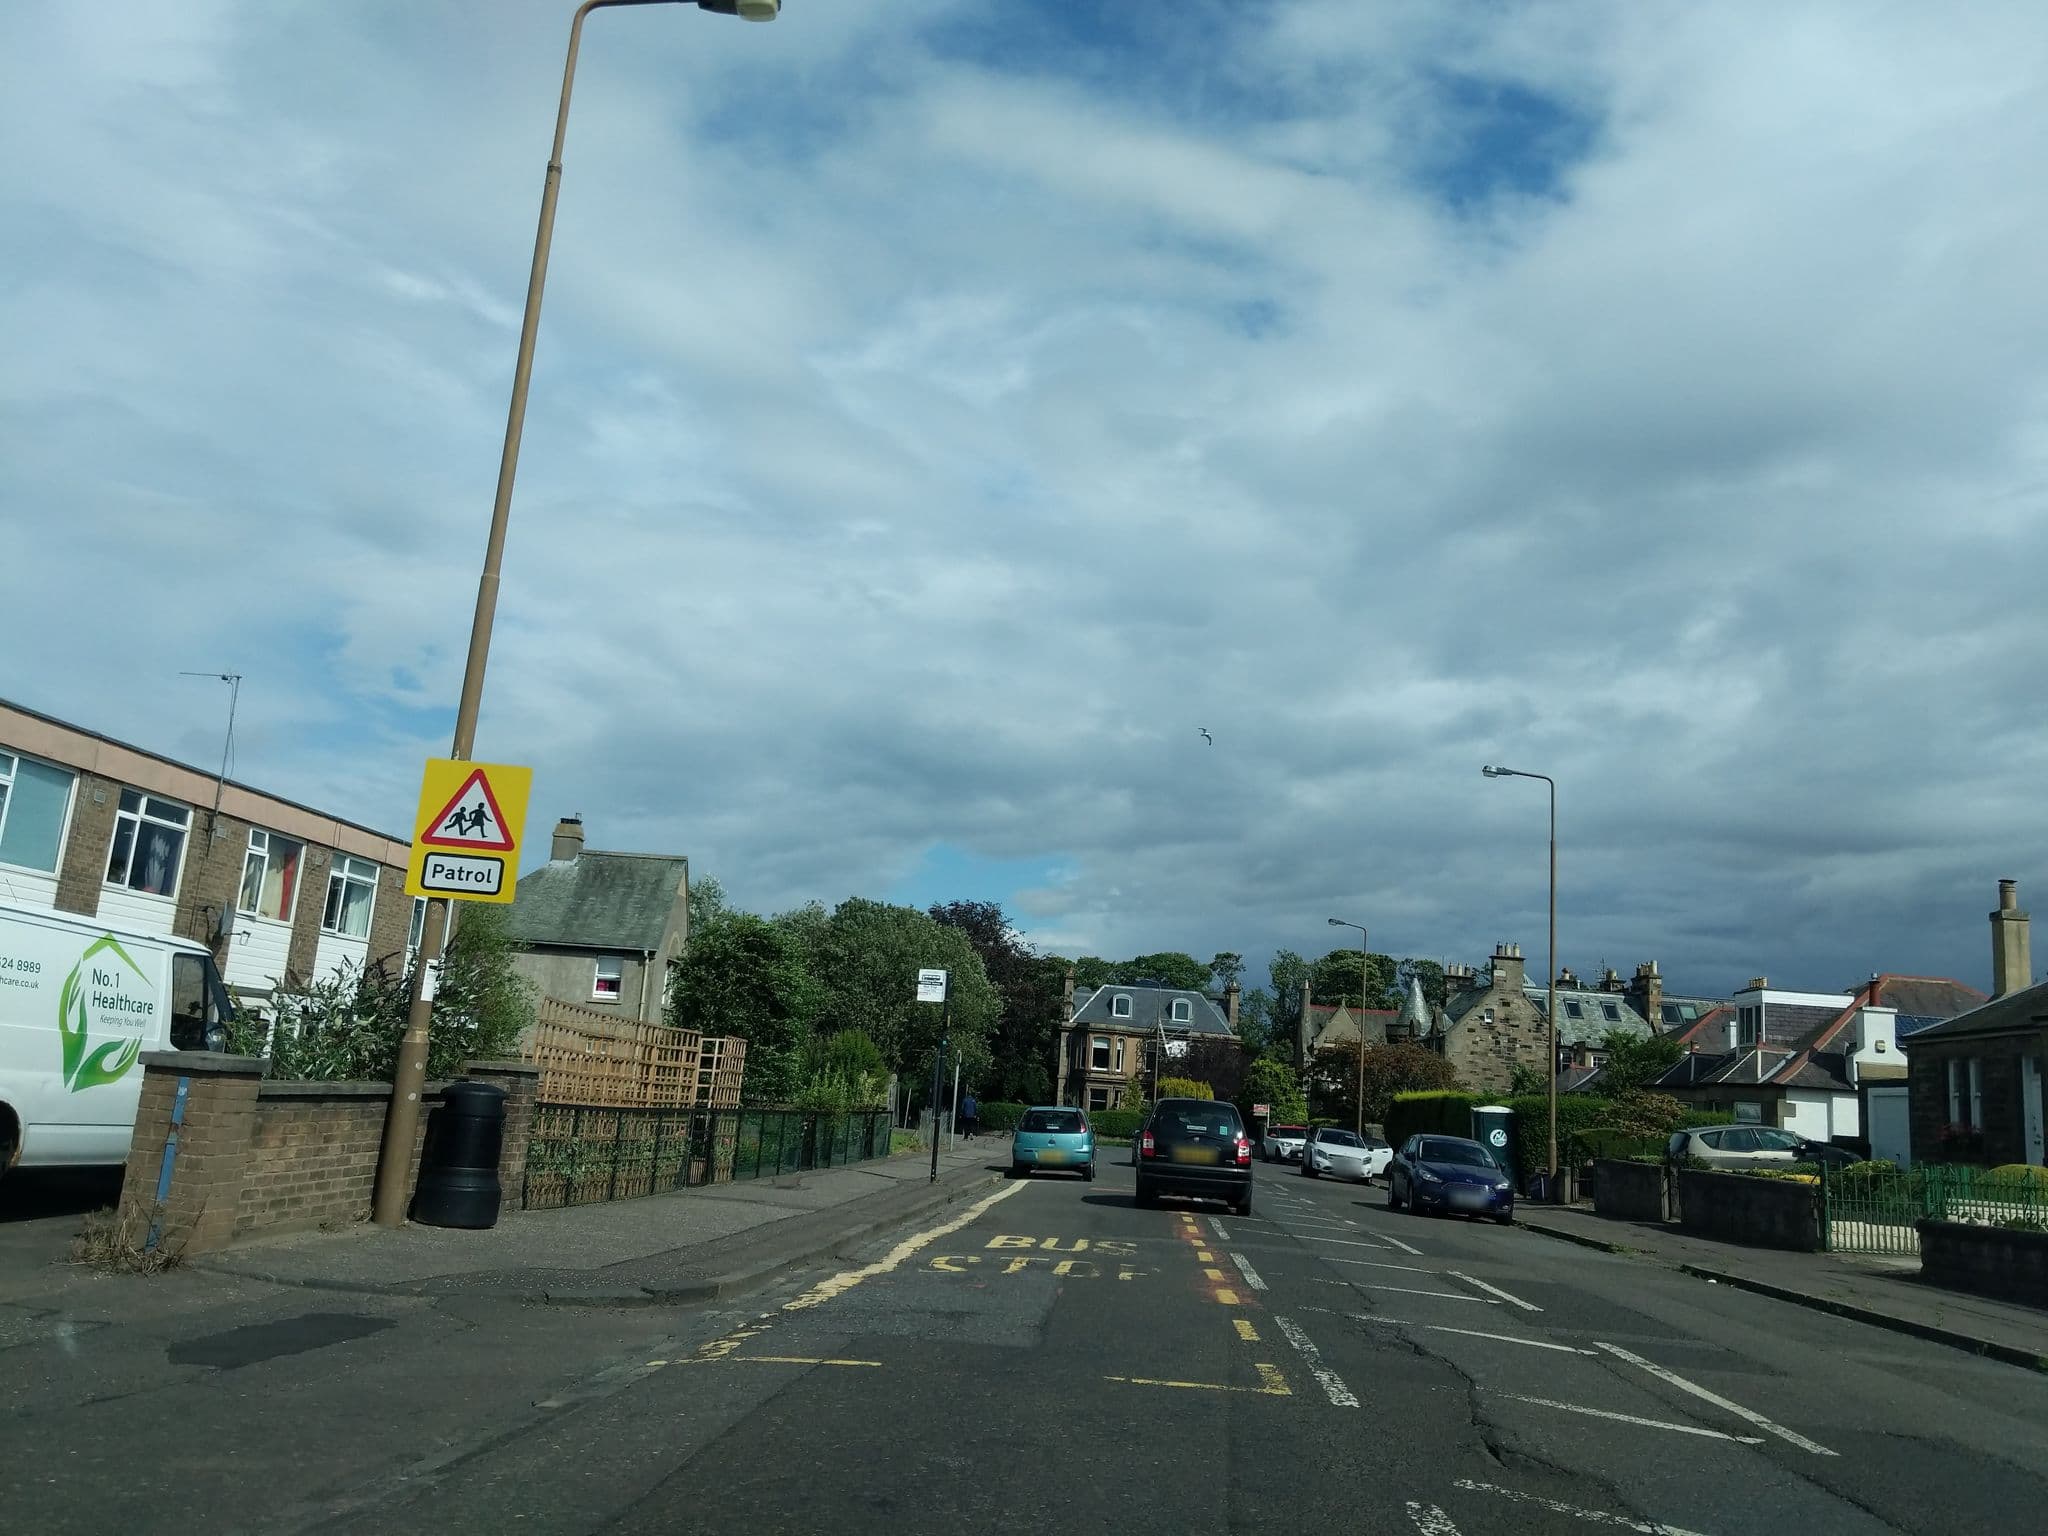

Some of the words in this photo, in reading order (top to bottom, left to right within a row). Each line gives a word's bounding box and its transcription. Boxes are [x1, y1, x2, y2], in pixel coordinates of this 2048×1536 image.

[431, 863, 492, 884] Patrol
[0, 957, 14, 970] 24
[17, 959, 41, 974] 8989
[92, 990, 154, 1015] Healthcare
[100, 1014, 123, 1027] Keeping
[984, 1235, 1138, 1256] BUS
